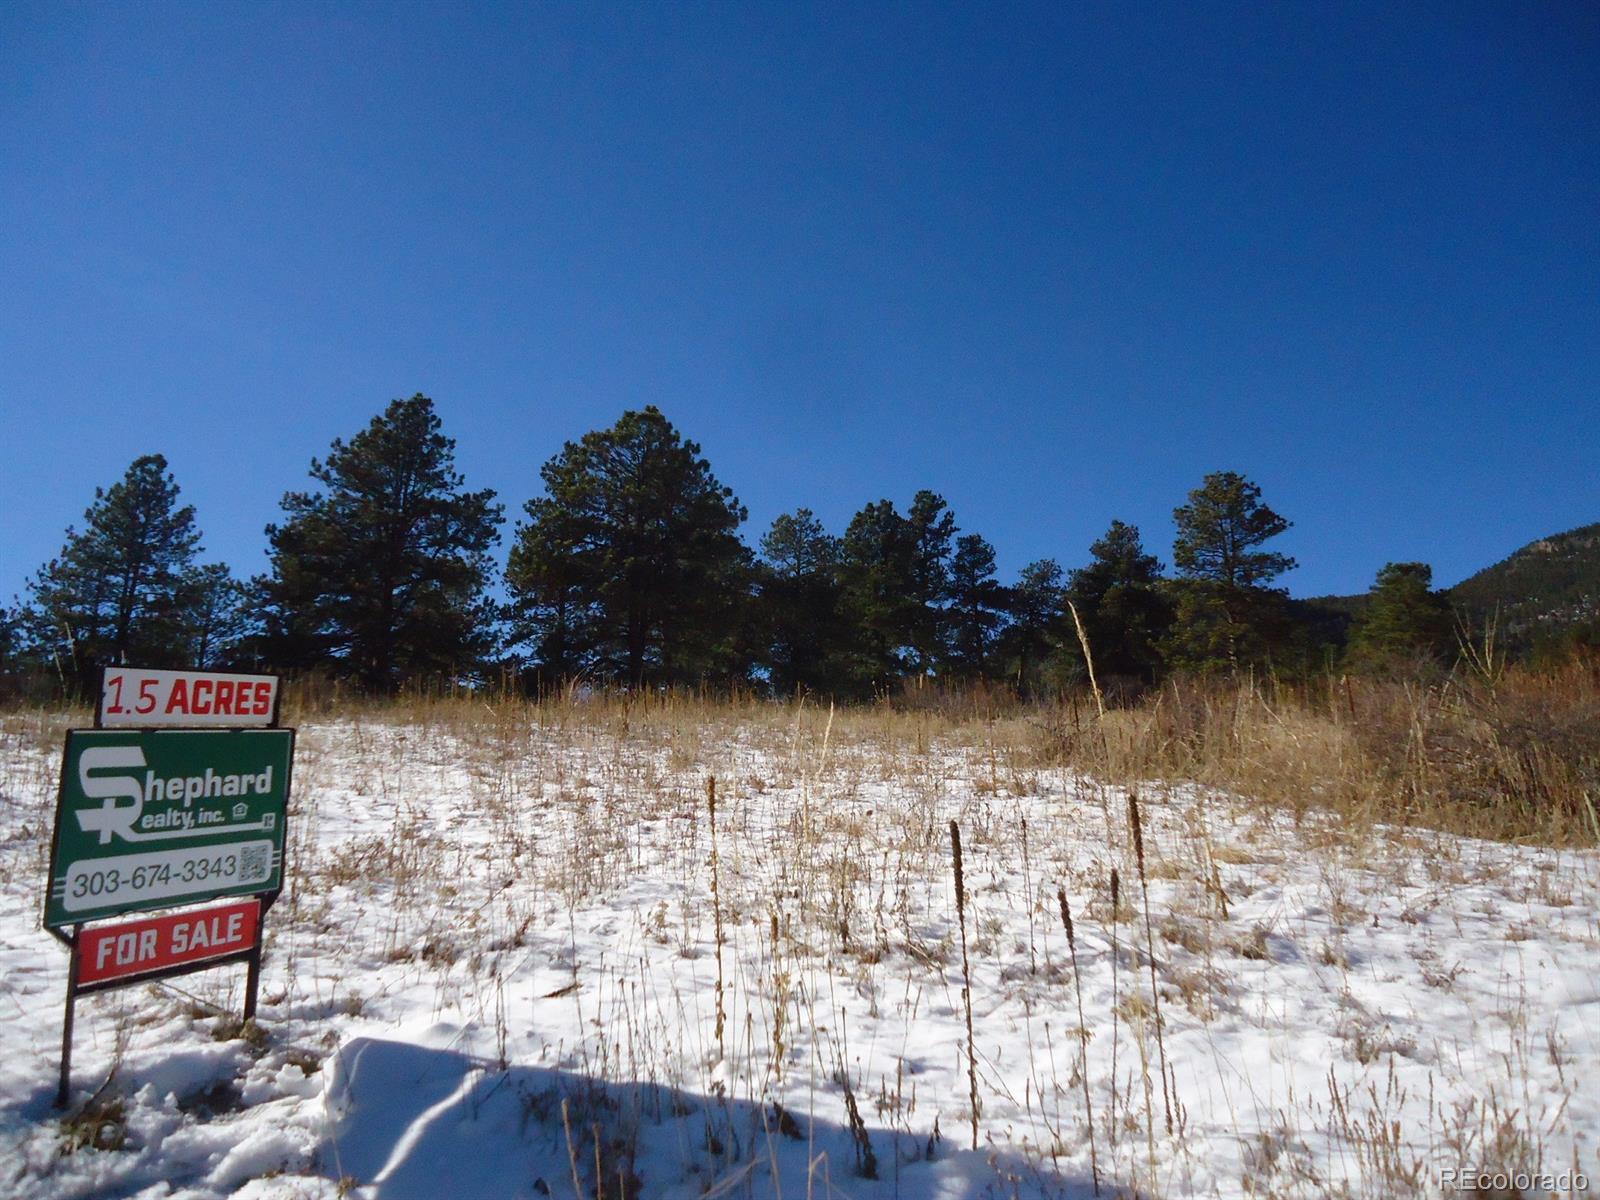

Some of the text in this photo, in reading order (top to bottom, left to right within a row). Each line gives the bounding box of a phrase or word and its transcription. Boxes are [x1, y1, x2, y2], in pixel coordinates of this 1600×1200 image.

[106, 675, 272, 716] 1.5 ACRES
[79, 746, 273, 808] Shephard
[198, 807, 225, 825] inc.
[72, 855, 237, 898] 303-674-3343
[96, 912, 244, 969] FOR SALE
